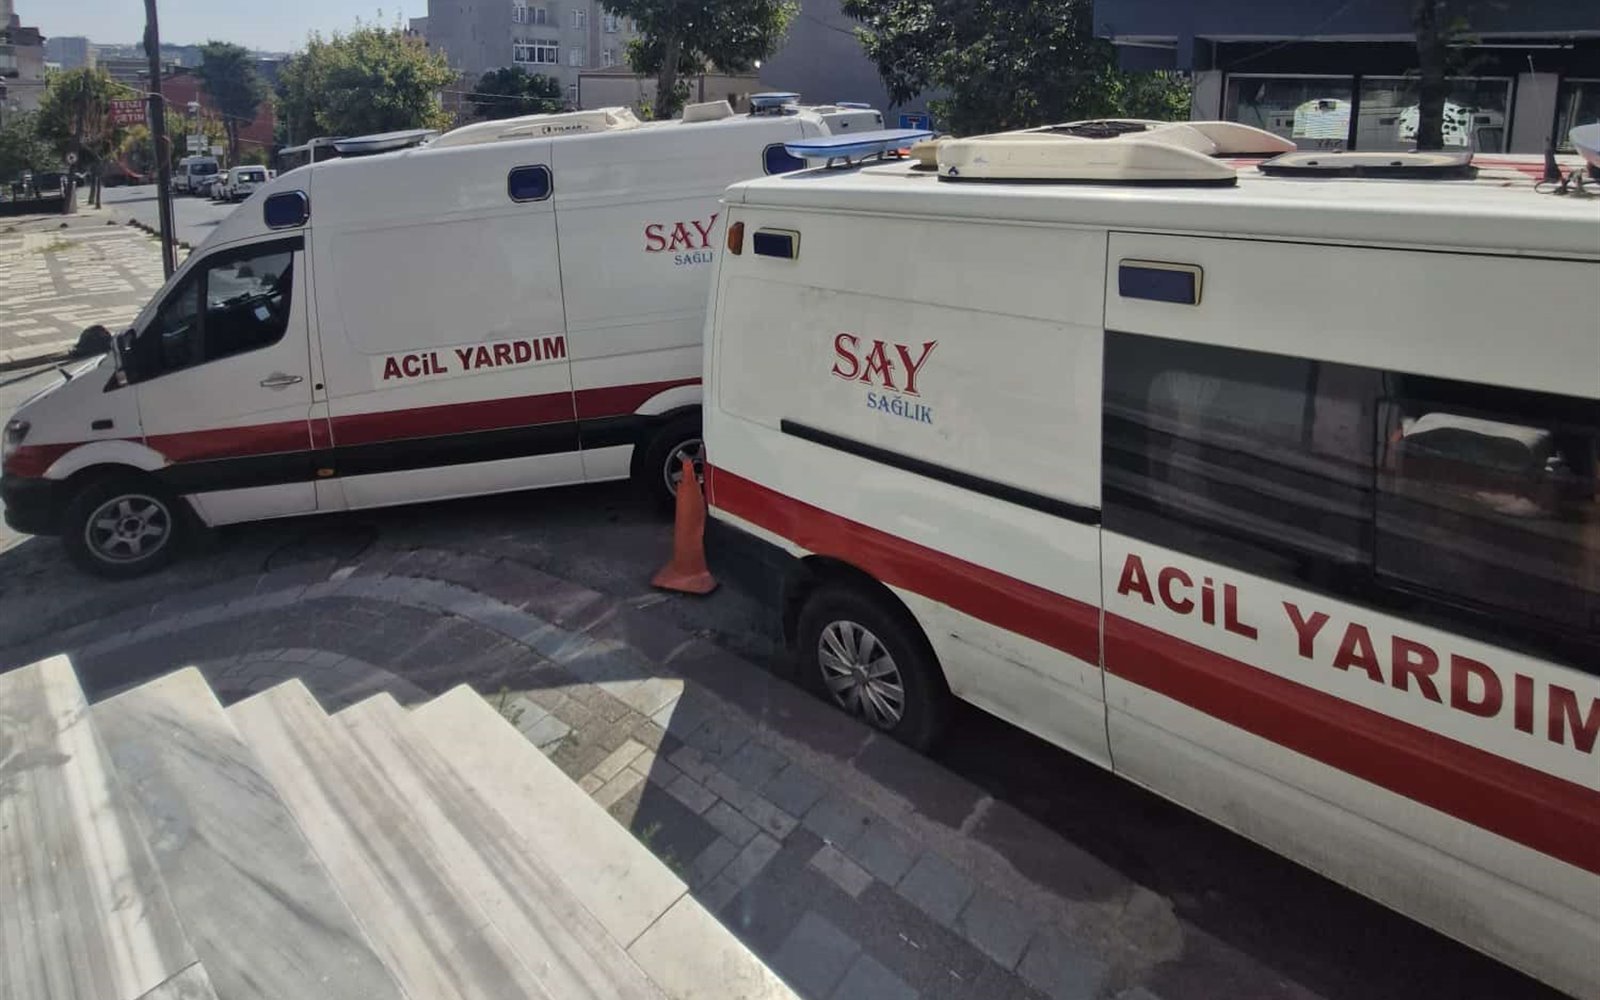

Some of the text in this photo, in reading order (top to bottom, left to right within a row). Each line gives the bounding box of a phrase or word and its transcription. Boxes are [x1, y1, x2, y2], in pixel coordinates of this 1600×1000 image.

[644, 213, 719, 253] SAY
[674, 251, 713, 266] SAĞLI
[454, 335, 567, 371] YARDIM
[832, 332, 939, 397] SAY
[866, 391, 934, 424] SAĞLIK
[1282, 601, 1600, 754] YARDIM
